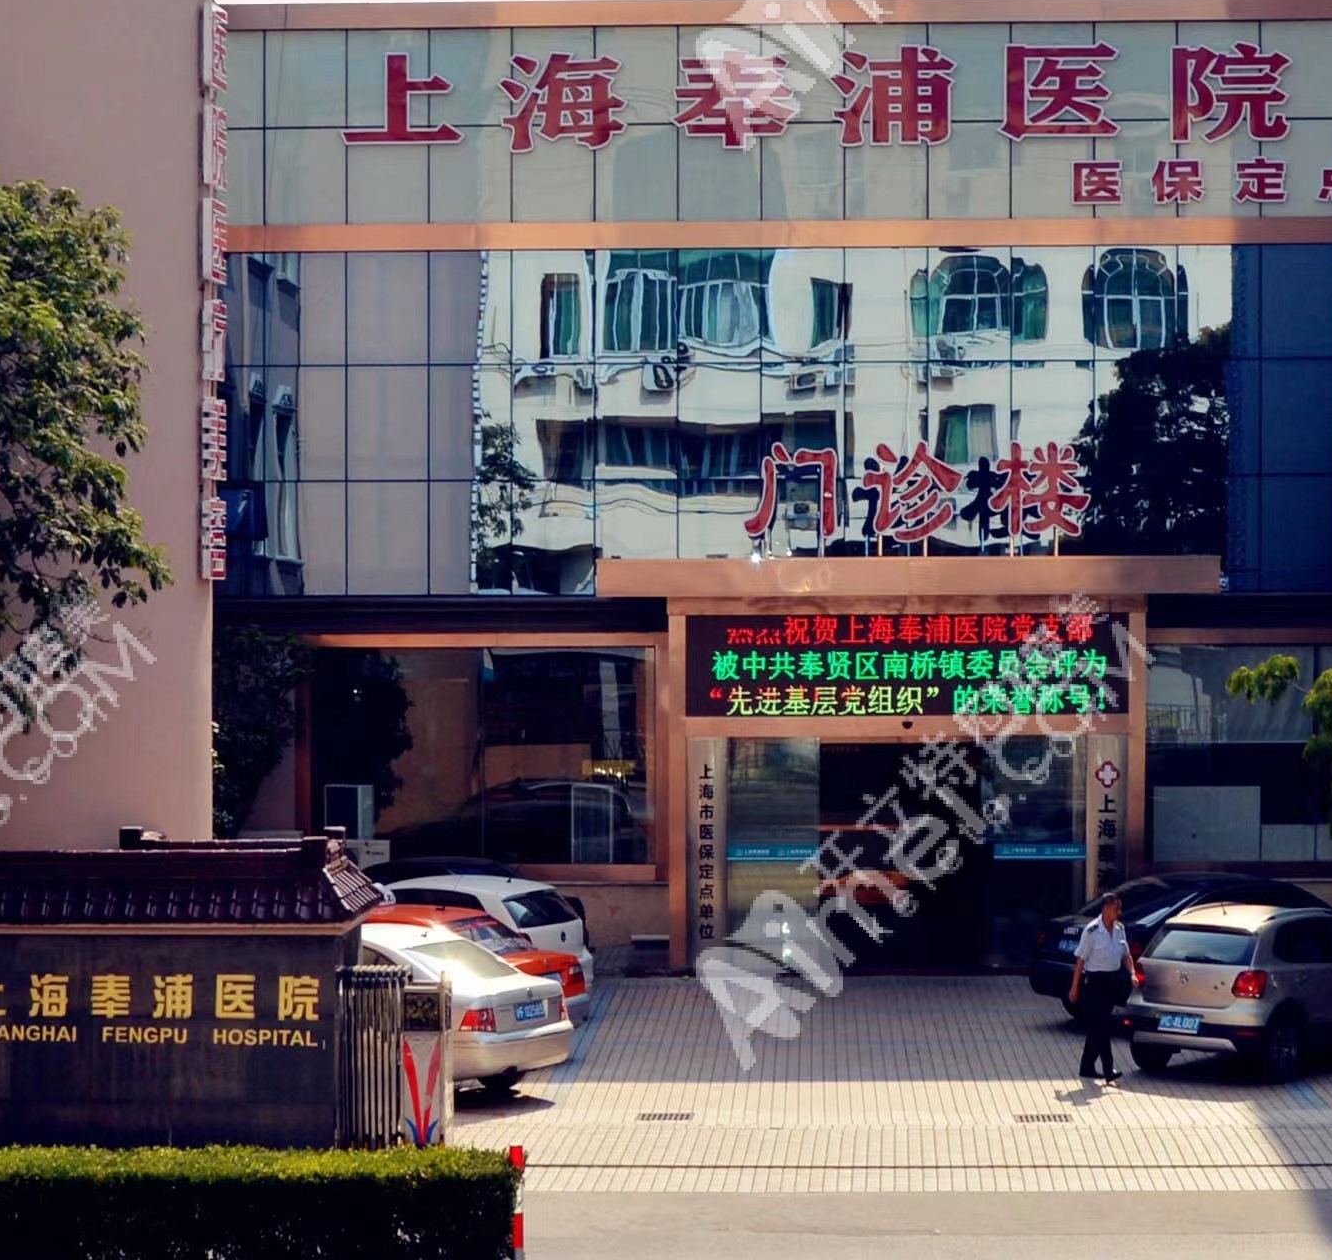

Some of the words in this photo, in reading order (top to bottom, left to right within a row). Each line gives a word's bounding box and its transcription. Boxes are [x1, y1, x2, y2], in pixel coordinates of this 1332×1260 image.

[341, 41, 1293, 153] 上海奉浦医院
[744, 440, 1092, 542] 门诊楼
[712, 650, 1107, 681] 被中共奉贤区南桥镇委员会评为
[698, 763, 715, 941] 上海市医保定点单位
[102, 1026, 188, 1045] FENGPU
[213, 1028, 319, 1048] HOSPITAL
